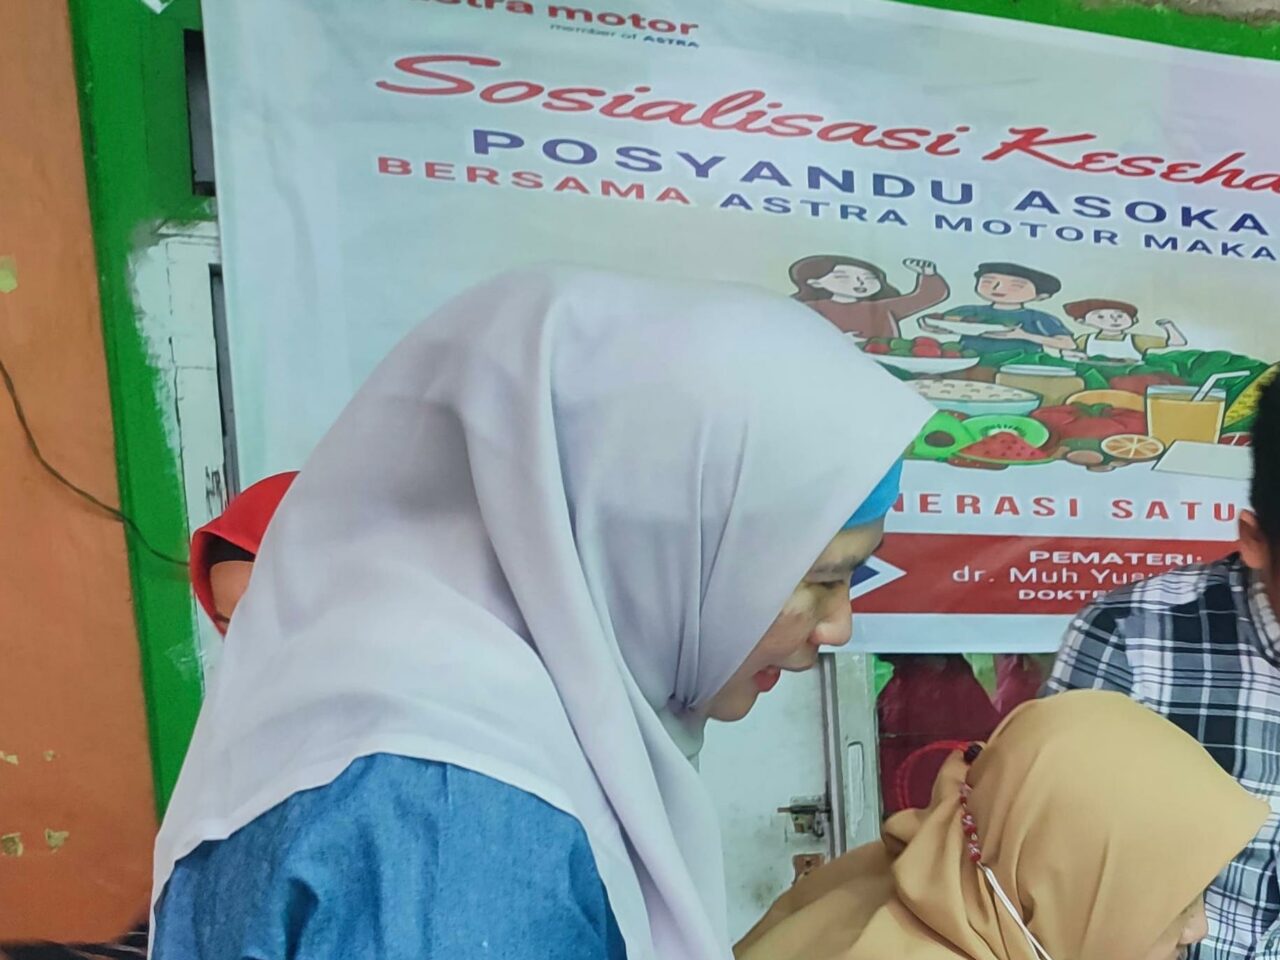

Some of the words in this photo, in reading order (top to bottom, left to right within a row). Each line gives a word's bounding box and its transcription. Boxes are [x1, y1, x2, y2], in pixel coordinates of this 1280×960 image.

[548, 5, 699, 35] motor
[643, 35, 699, 48] ASTRA
[376, 55, 970, 156] Sosialisasi
[473, 129, 974, 204] POSYANDU
[1014, 190, 1270, 236] ASOKA
[378, 156, 692, 204] BERSAMA
[719, 193, 908, 226] ASTRA
[934, 214, 1119, 246] MOTOR
[1111, 499, 1235, 522] SATU
[953, 566, 995, 582] dr.
[1009, 567, 1077, 584] Muh
